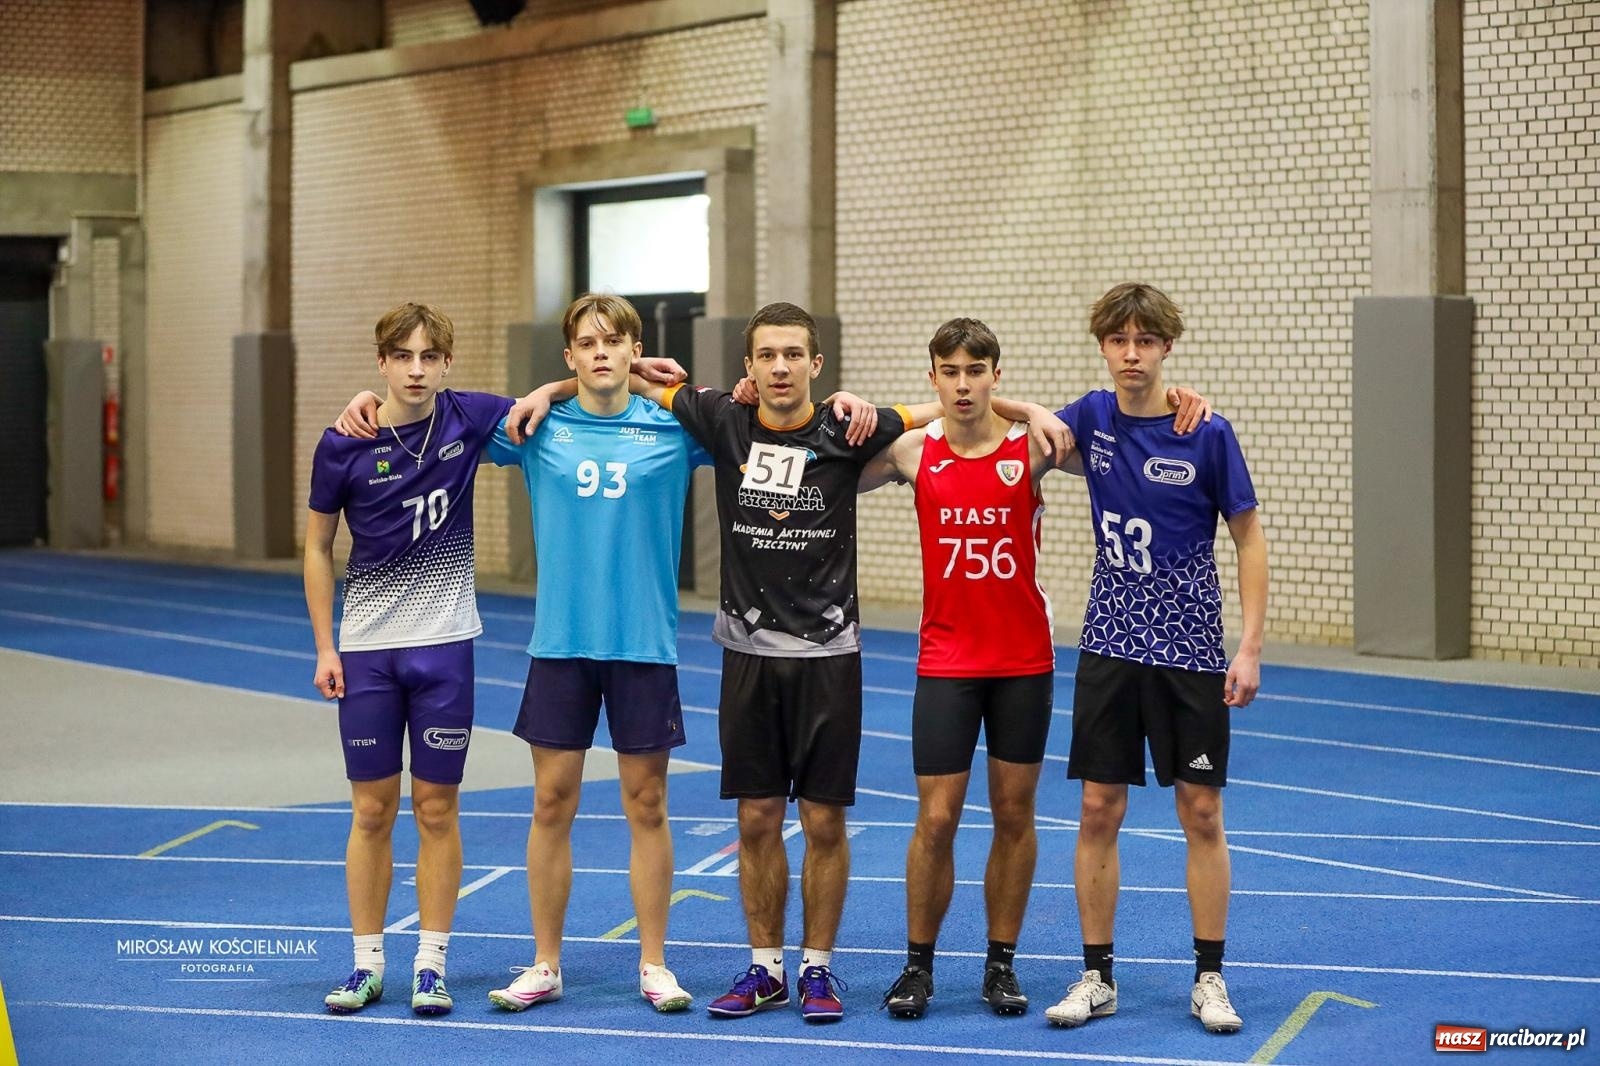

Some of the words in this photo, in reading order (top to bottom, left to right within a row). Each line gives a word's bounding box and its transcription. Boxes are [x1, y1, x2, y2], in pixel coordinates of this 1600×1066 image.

[633, 434, 657, 442] TEAM
[576, 459, 628, 499] 93
[751, 451, 796, 489] 51
[738, 494, 826, 511] PSZCZYNA.PL
[402, 488, 449, 542] 70
[940, 507, 1012, 525] PIAST
[732, 521, 774, 537] AKADEMIA
[777, 527, 837, 539] AKTYWNEJ
[751, 537, 808, 551] PSZCZYNY
[1101, 510, 1152, 575] 53
[938, 537, 1017, 580] 756
[1188, 762, 1214, 771] adidas
